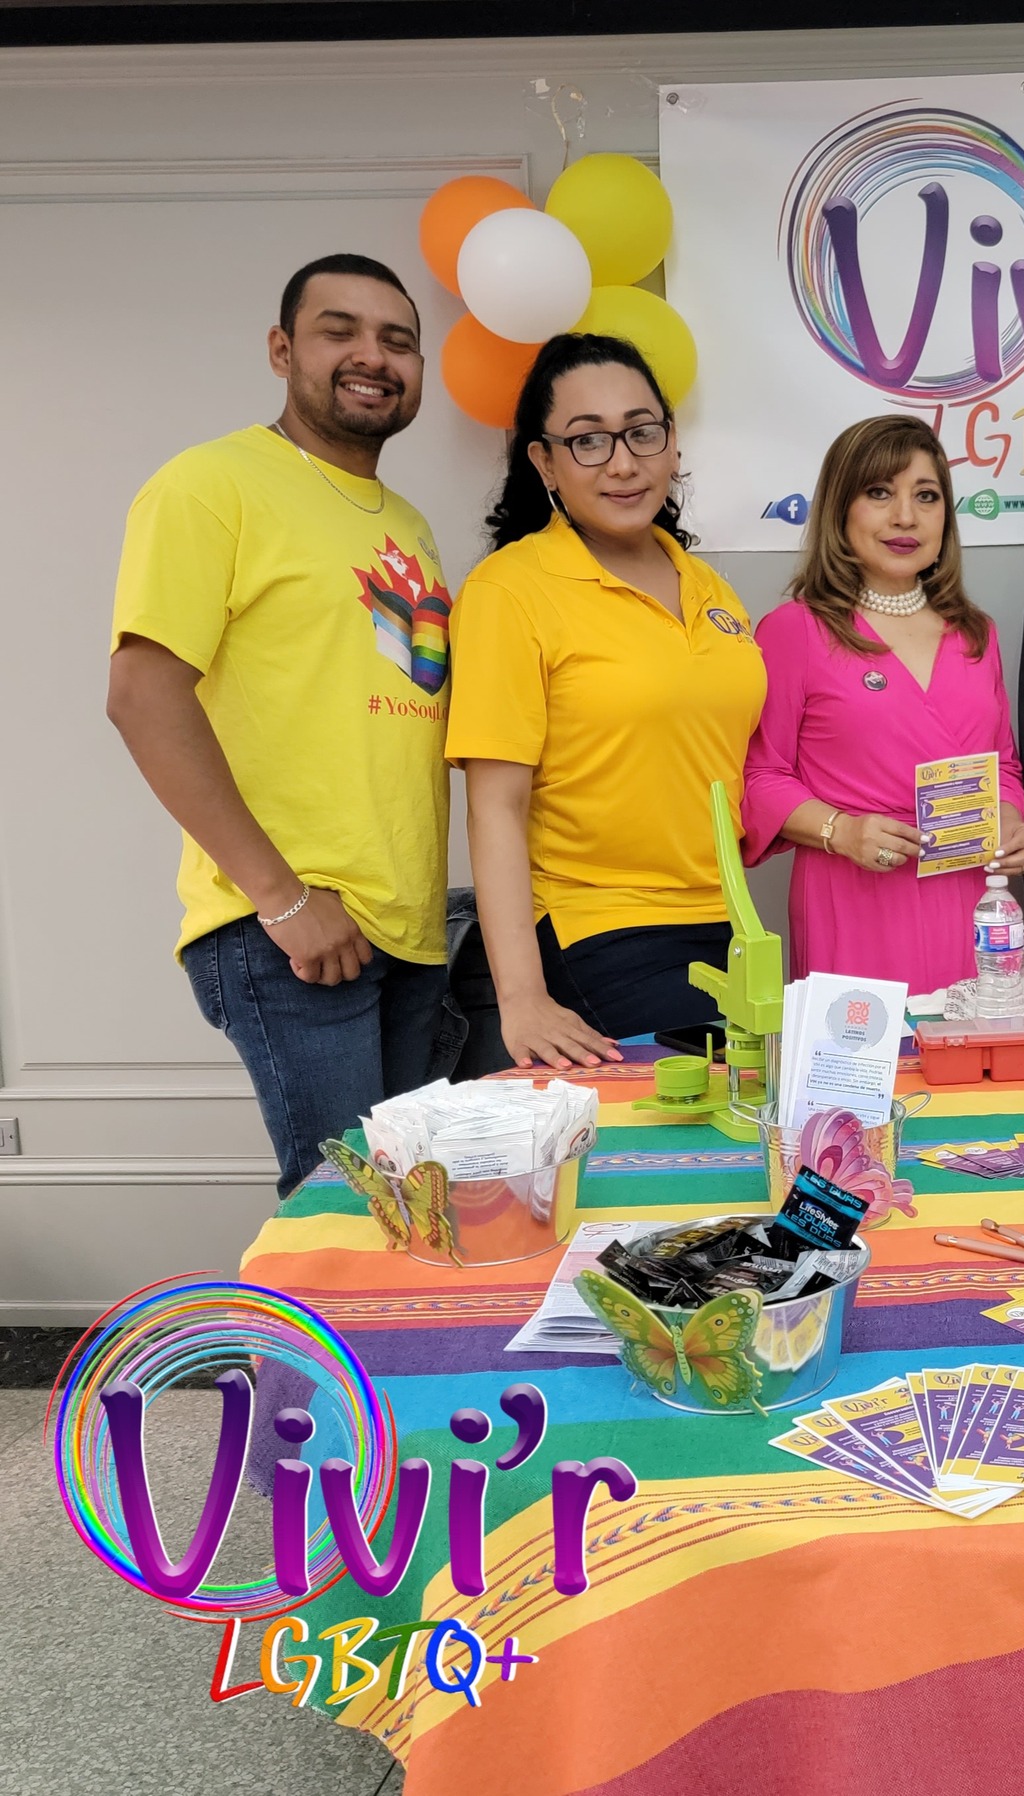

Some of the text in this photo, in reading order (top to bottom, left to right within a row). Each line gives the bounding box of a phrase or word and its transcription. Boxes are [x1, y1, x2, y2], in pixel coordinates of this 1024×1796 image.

[829, 1185, 863, 1209] DURS
[785, 1209, 807, 1227] LES
[799, 1201, 840, 1230] LifeStyles
[799, 1209, 836, 1237] TOUGH
[845, 1397, 888, 1412] Vivi'r
